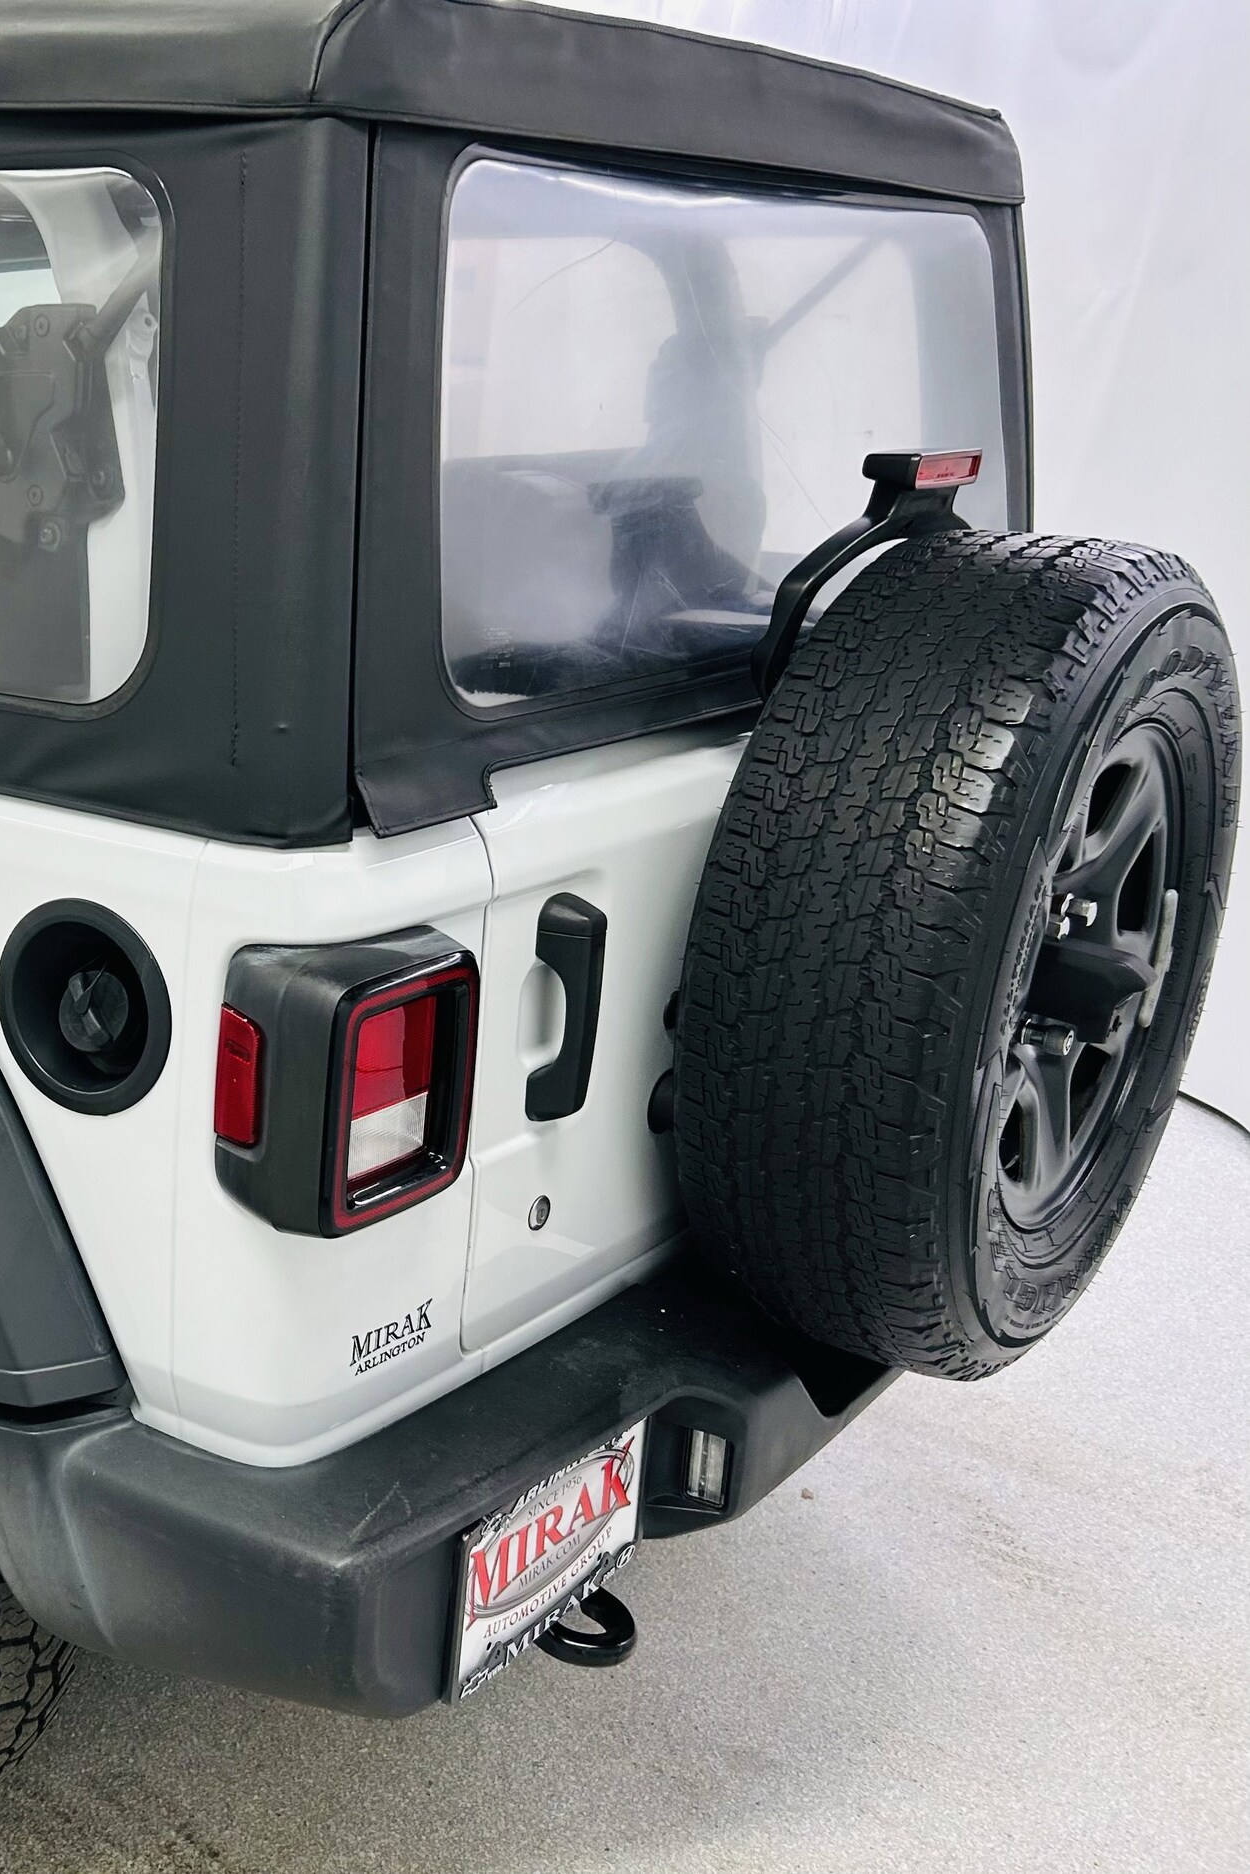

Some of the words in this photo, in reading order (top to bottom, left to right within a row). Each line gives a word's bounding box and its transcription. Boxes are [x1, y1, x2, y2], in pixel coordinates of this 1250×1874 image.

[349, 1298, 432, 1367] MIRAK
[355, 1331, 425, 1376] ARLINGTON
[526, 1489, 560, 1521] SINCE
[561, 1473, 583, 1497] 1936
[465, 1435, 636, 1631] MIRAK
[517, 1533, 582, 1590] MIRAK.COM
[484, 1574, 567, 1638] AUTOMOTIVE
[570, 1525, 613, 1573] GROUP
